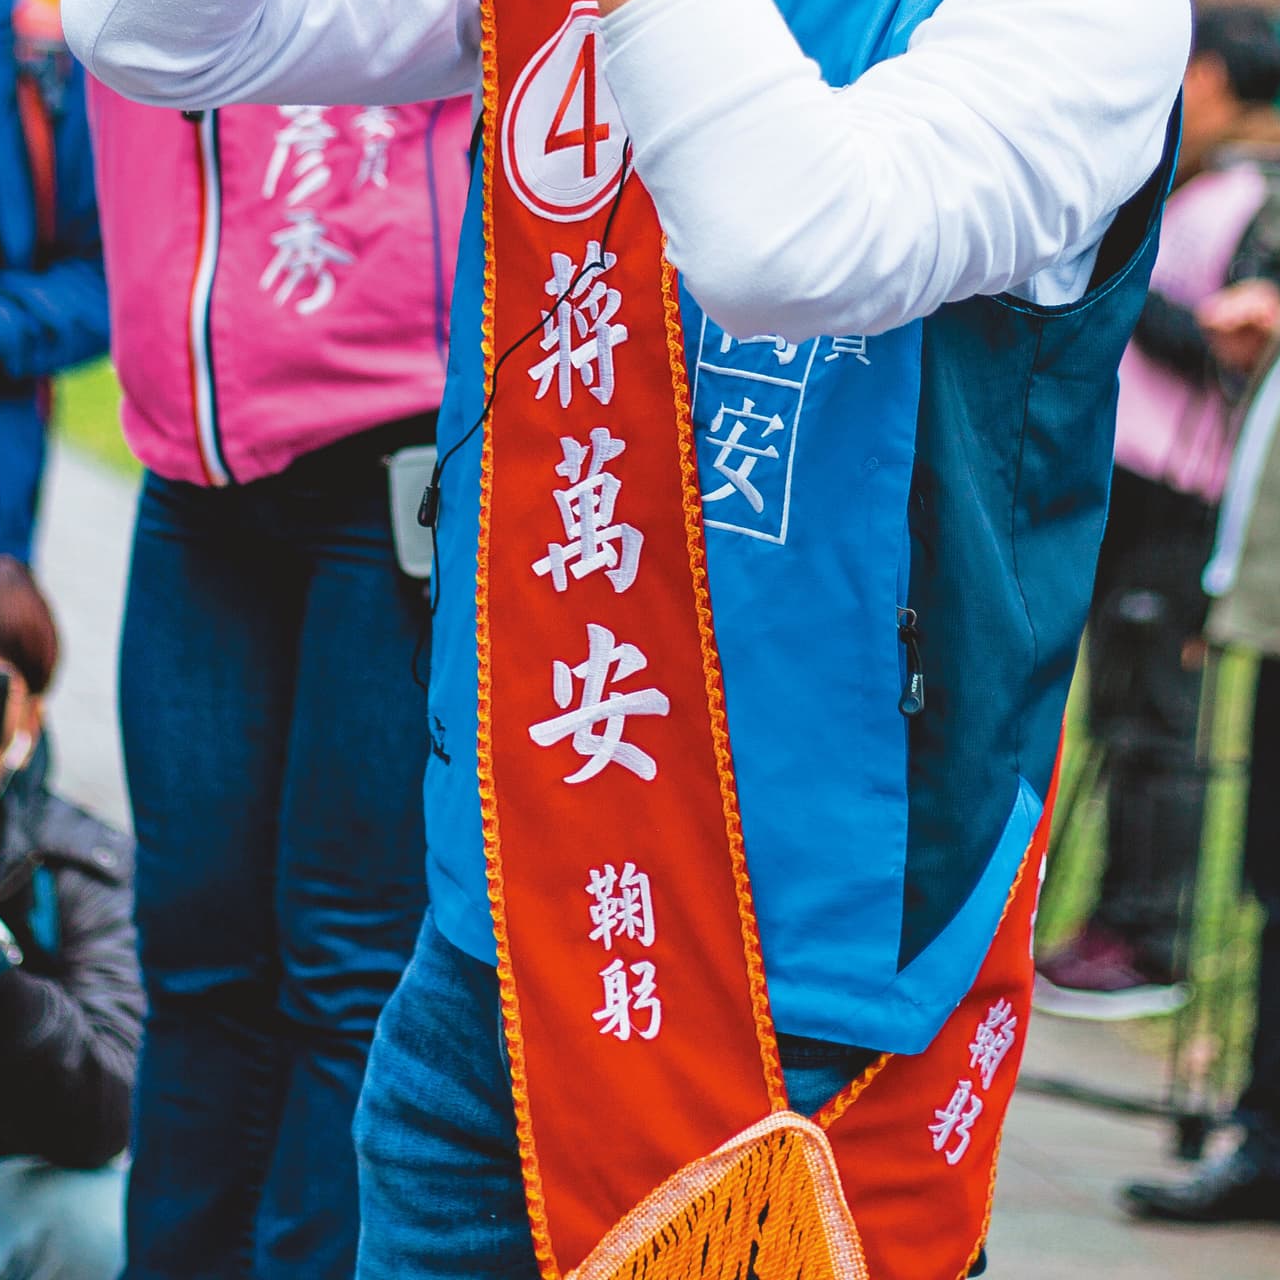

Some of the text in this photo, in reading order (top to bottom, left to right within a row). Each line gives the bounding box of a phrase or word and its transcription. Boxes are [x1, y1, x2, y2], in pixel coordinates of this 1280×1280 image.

[544, 32, 609, 178] 4
[528, 239, 669, 785] 蔣萬安
[586, 862, 663, 1041] 鞠躬
[927, 997, 1017, 1166] 鞠躬
